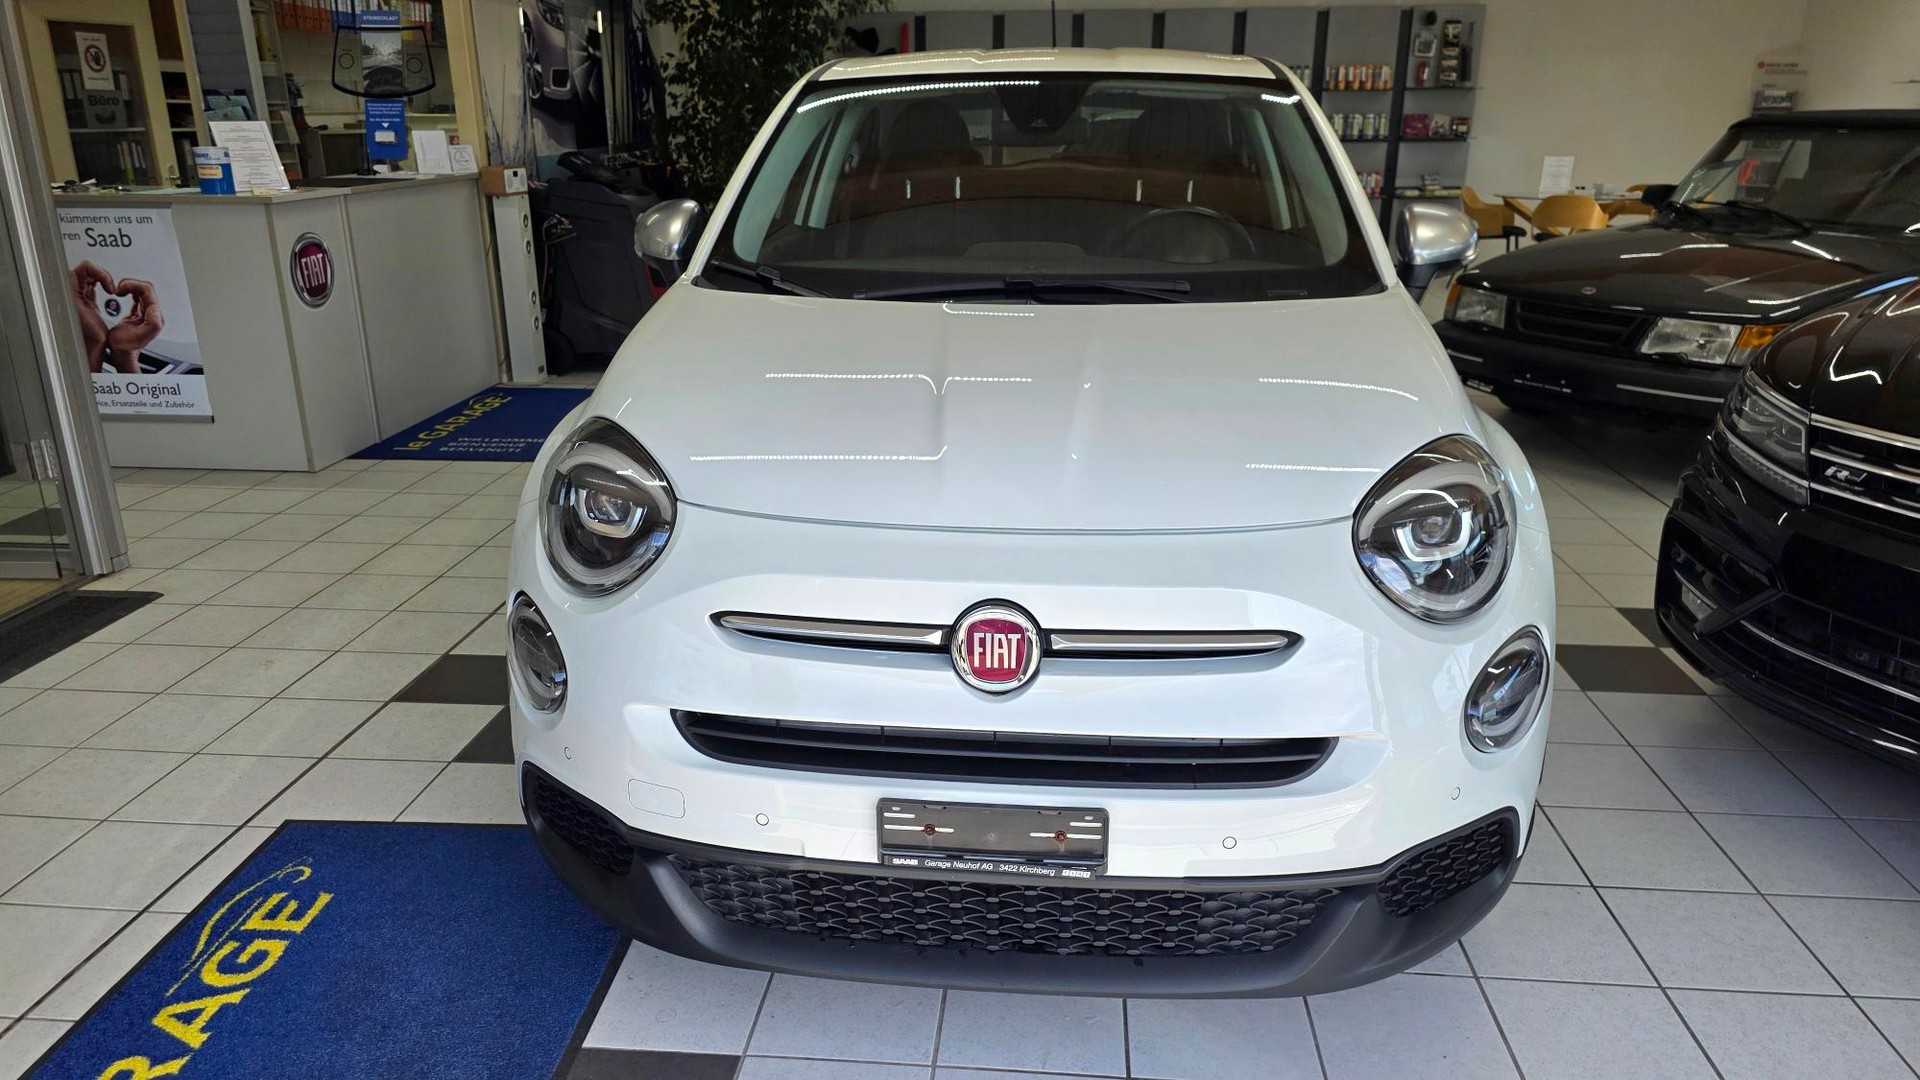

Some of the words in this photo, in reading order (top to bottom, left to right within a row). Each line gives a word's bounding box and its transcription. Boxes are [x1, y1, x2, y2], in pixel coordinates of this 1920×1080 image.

[88, 95, 120, 106] Büro
[59, 213, 111, 224] kümmern
[114, 215, 133, 224] uns
[135, 215, 153, 224] um
[84, 227, 132, 248] Saab
[301, 253, 326, 289] FIAT
[92, 381, 121, 395] Saab
[126, 382, 181, 399] Original
[165, 401, 195, 409] Zubehör
[418, 396, 513, 440] GARAGE
[973, 632, 1022, 669] FIAT
[924, 859, 951, 869] Garage
[952, 861, 980, 870] Neuhof
[980, 862, 993, 870] AG
[999, 864, 1018, 872] 3422
[1019, 865, 1055, 876] Kirchberg
